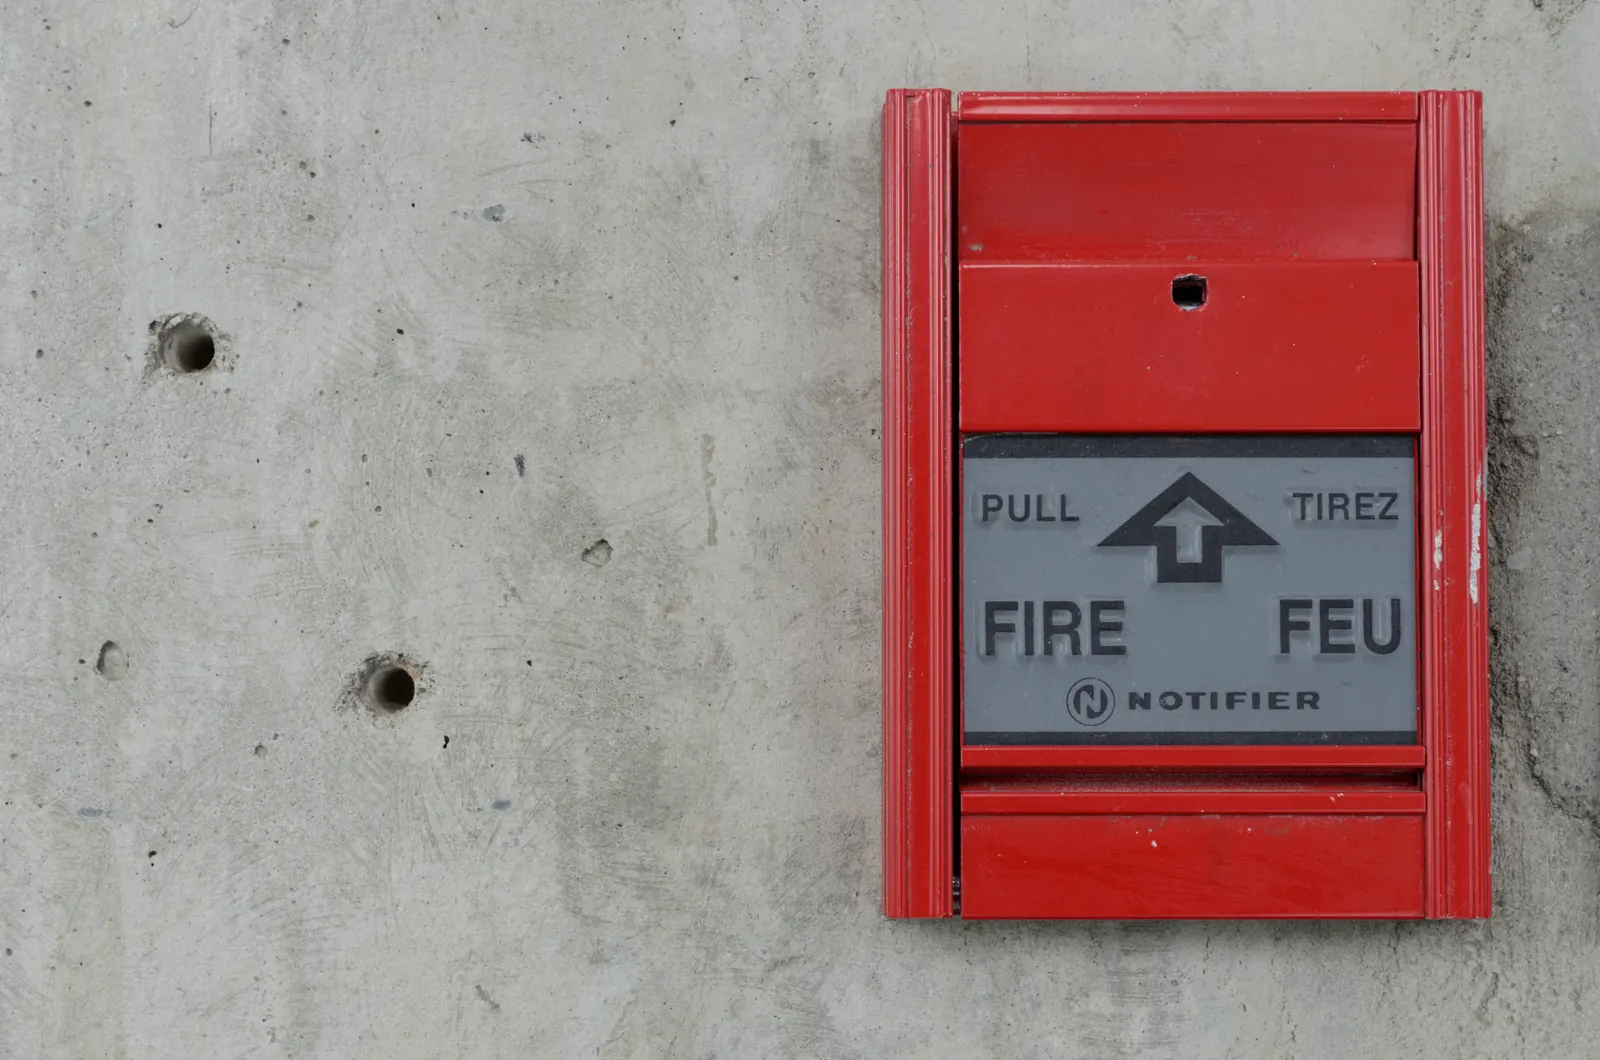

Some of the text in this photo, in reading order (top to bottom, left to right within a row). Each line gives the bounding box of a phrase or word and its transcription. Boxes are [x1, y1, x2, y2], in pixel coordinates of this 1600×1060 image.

[981, 494, 1079, 522] PULL
[1292, 492, 1399, 520] TIREZ
[984, 600, 1127, 656] FIRE
[1279, 598, 1401, 654] FEU
[1070, 681, 1320, 722] N NOTIFIER
